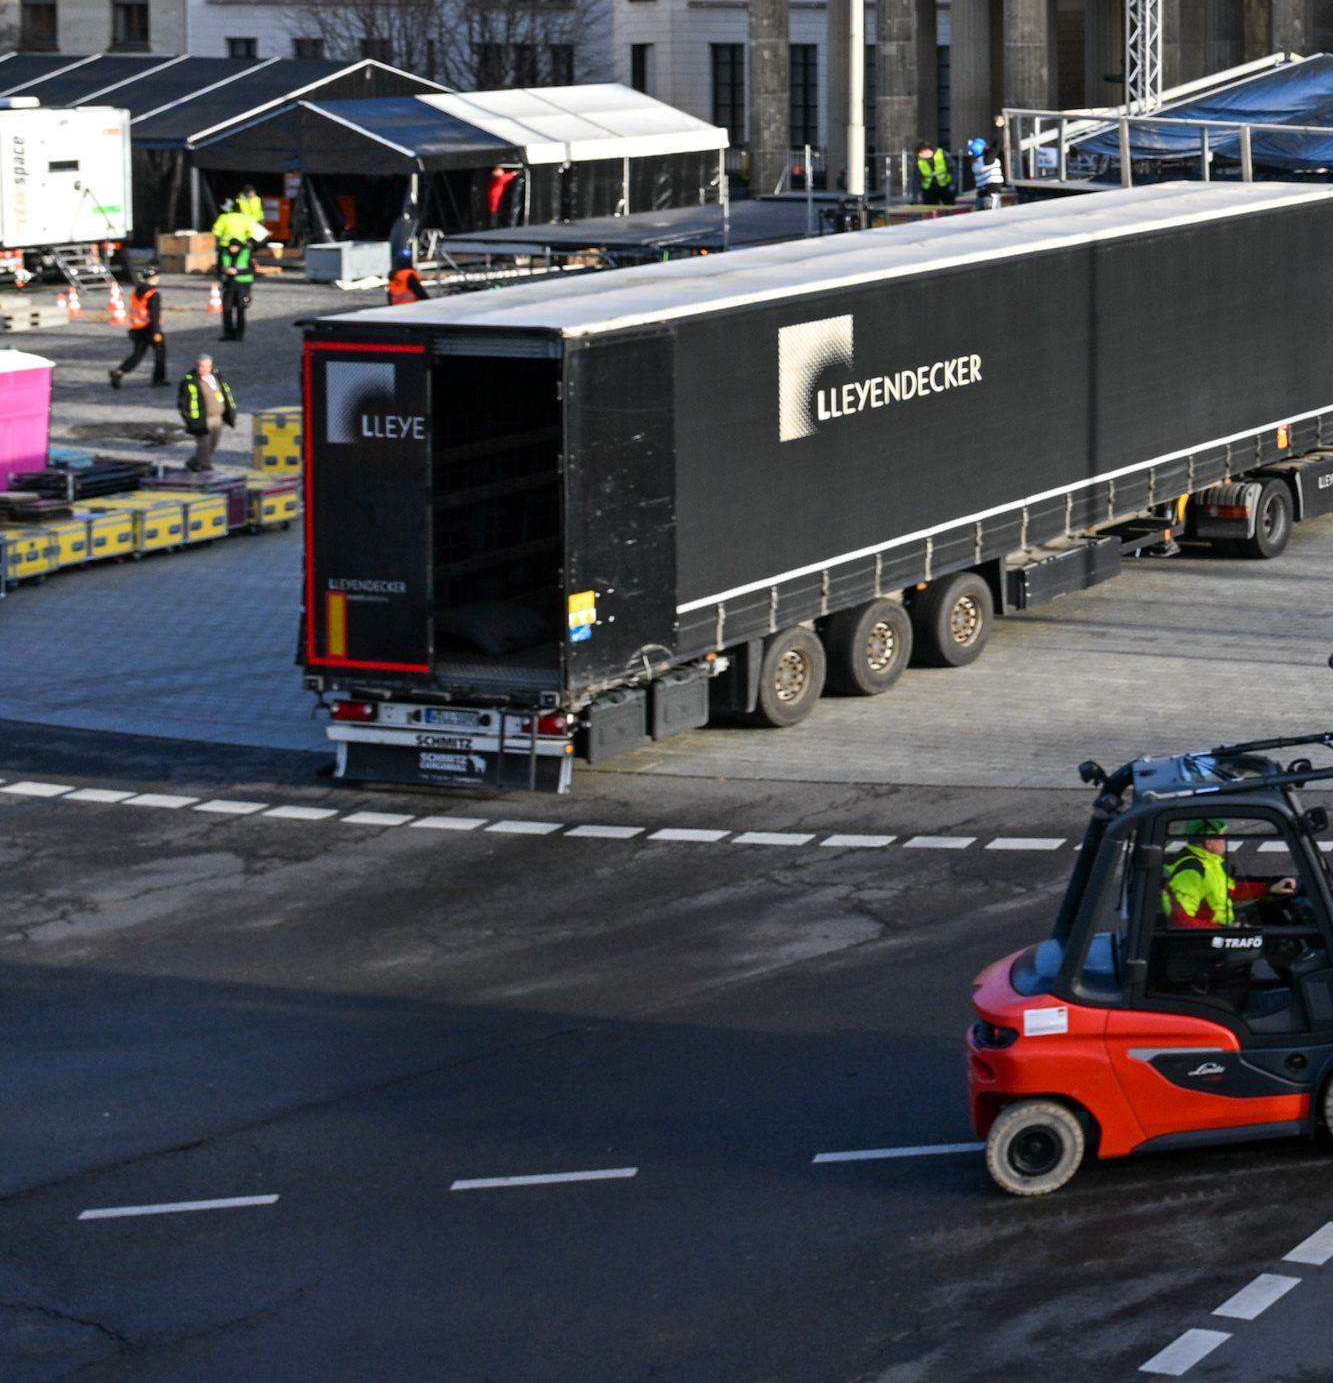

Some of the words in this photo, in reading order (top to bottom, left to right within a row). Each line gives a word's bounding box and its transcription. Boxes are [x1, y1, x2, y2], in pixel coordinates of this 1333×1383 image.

[817, 353, 983, 421] LLEYENDECKER
[361, 414, 426, 440] LLEYE
[416, 734, 473, 749] SCHMITZ
